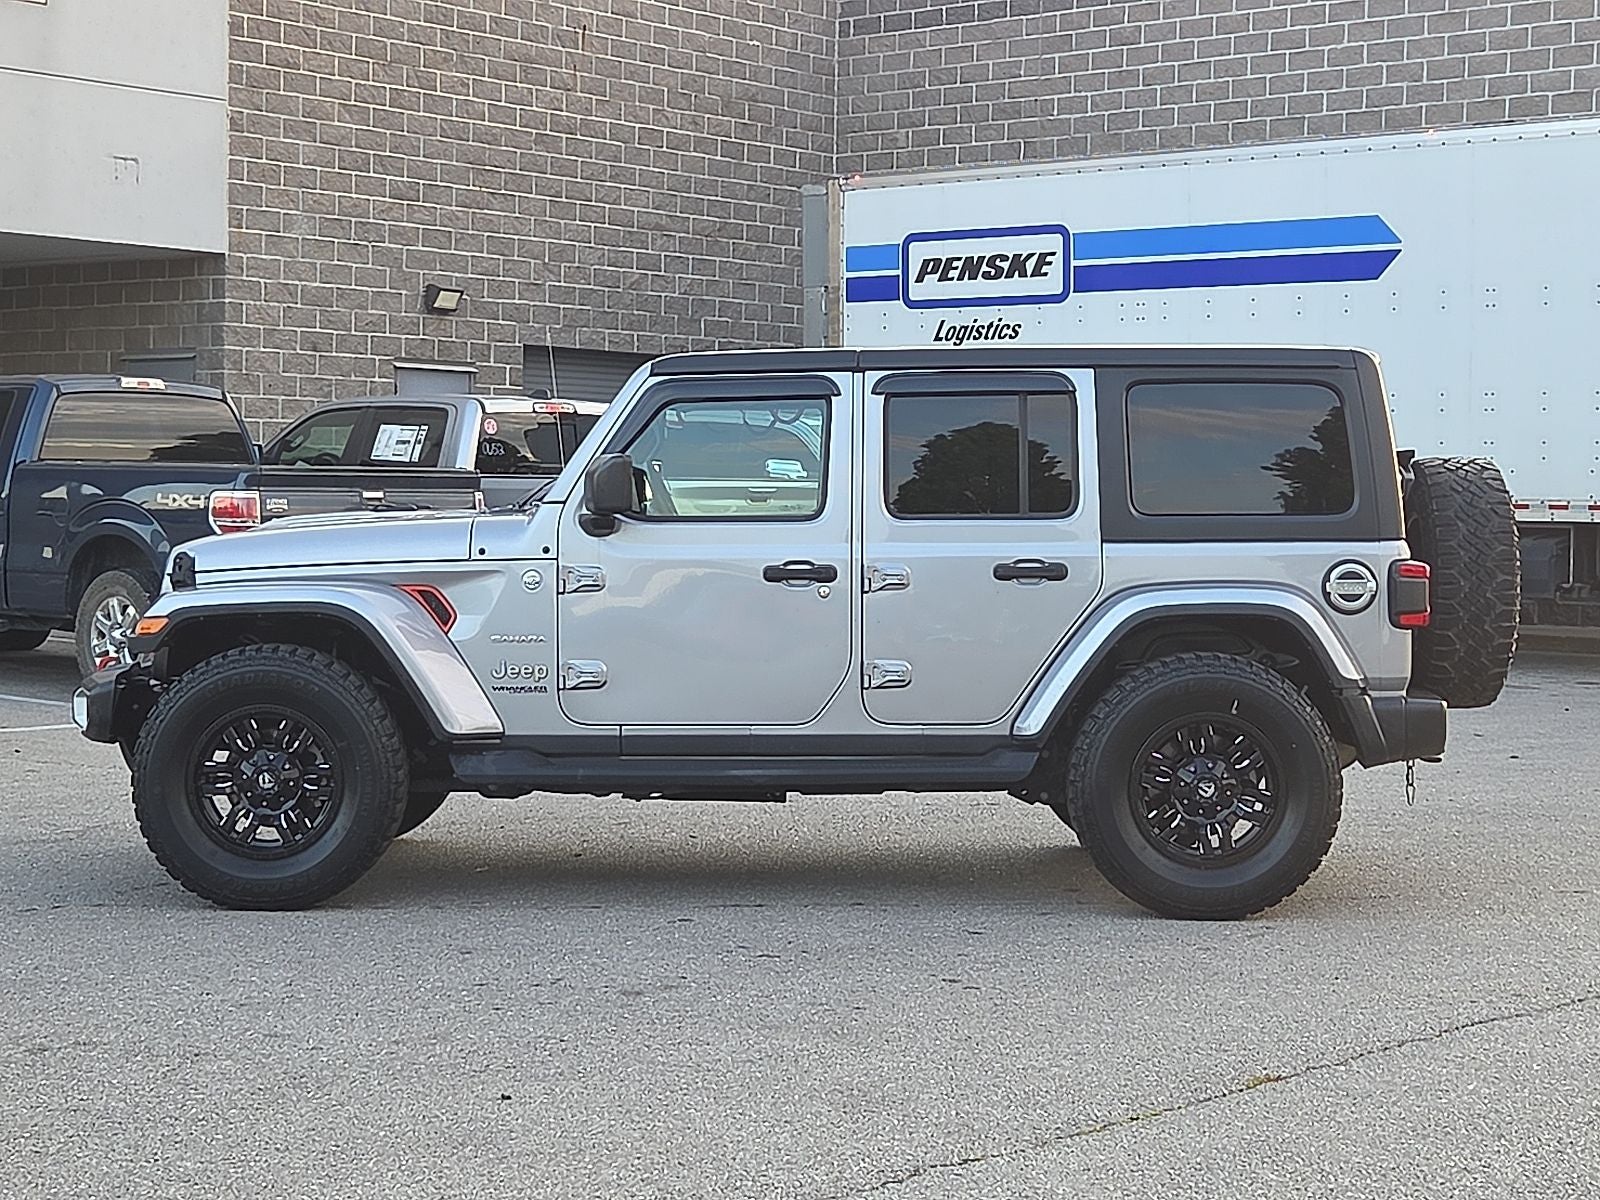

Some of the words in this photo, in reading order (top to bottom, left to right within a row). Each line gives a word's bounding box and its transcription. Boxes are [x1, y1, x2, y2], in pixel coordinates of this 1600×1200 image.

[914, 251, 1057, 284] PENSKE
[933, 317, 1022, 346] Logistics
[491, 660, 549, 682] Jeep
